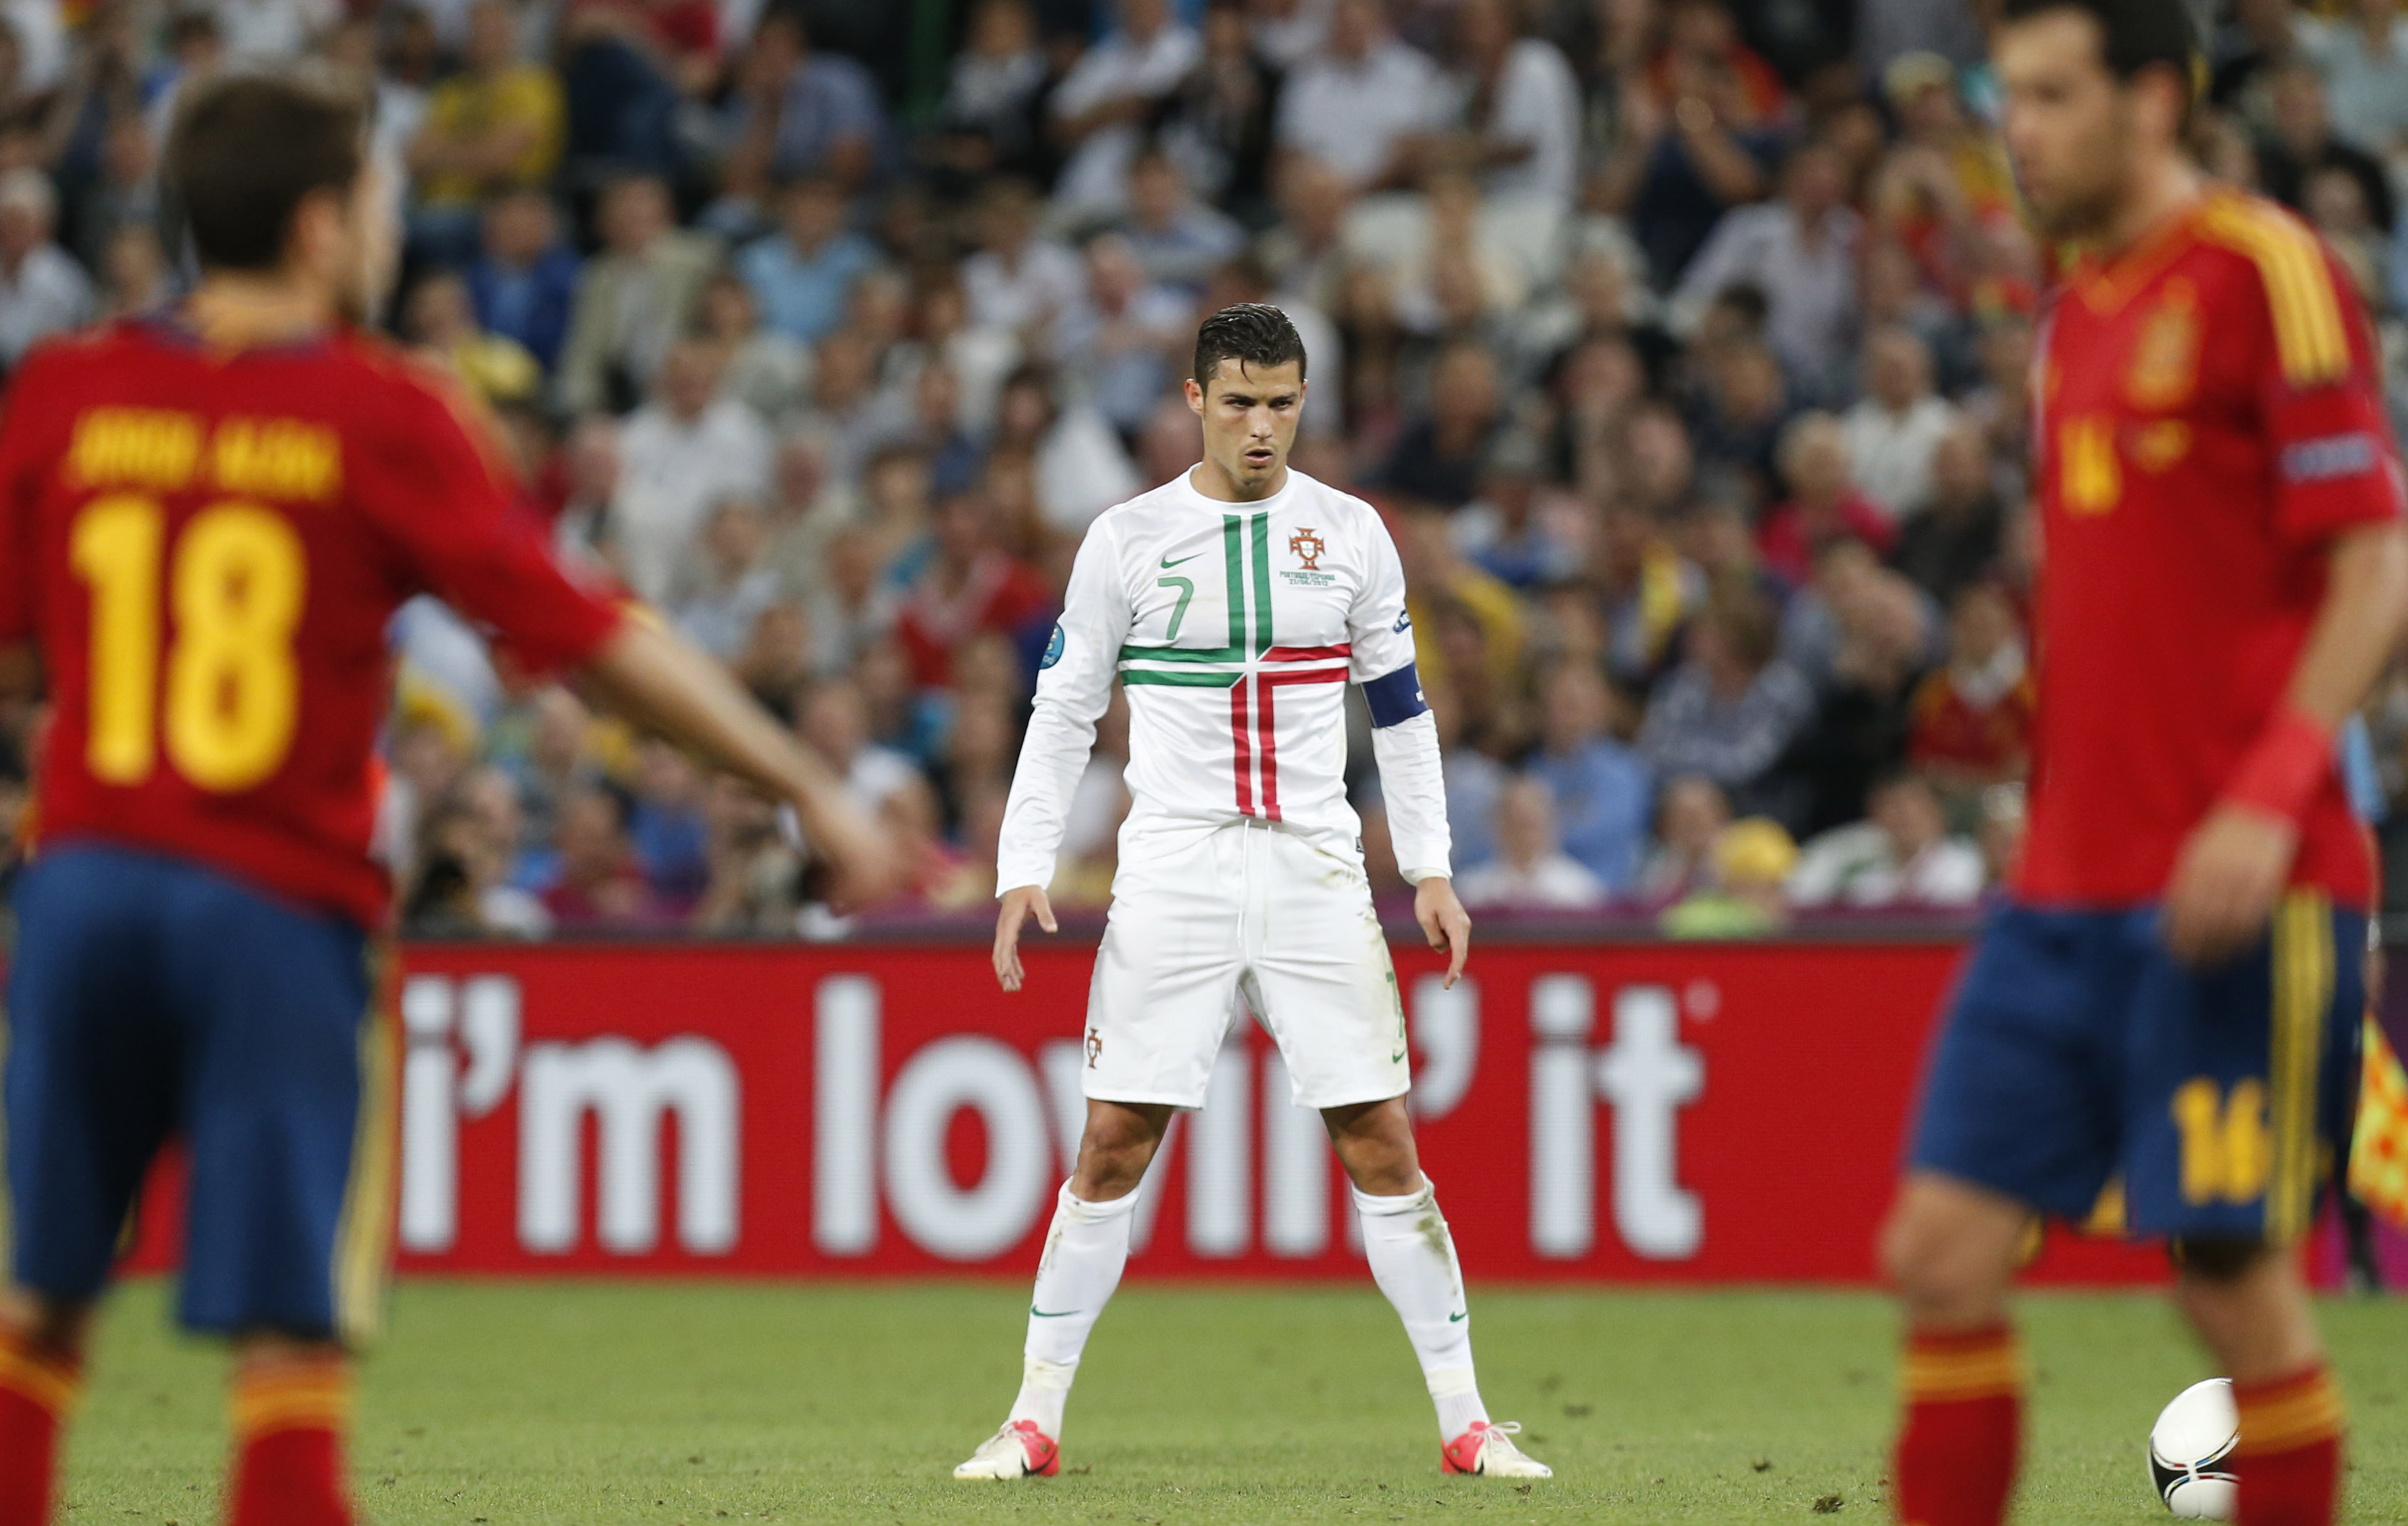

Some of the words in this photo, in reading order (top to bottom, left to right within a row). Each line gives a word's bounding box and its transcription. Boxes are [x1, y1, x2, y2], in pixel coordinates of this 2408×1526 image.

[68, 495, 305, 794] 18
[1157, 577, 1194, 640] 7
[400, 971, 741, 1256] i'm
[1528, 971, 1709, 1261] it
